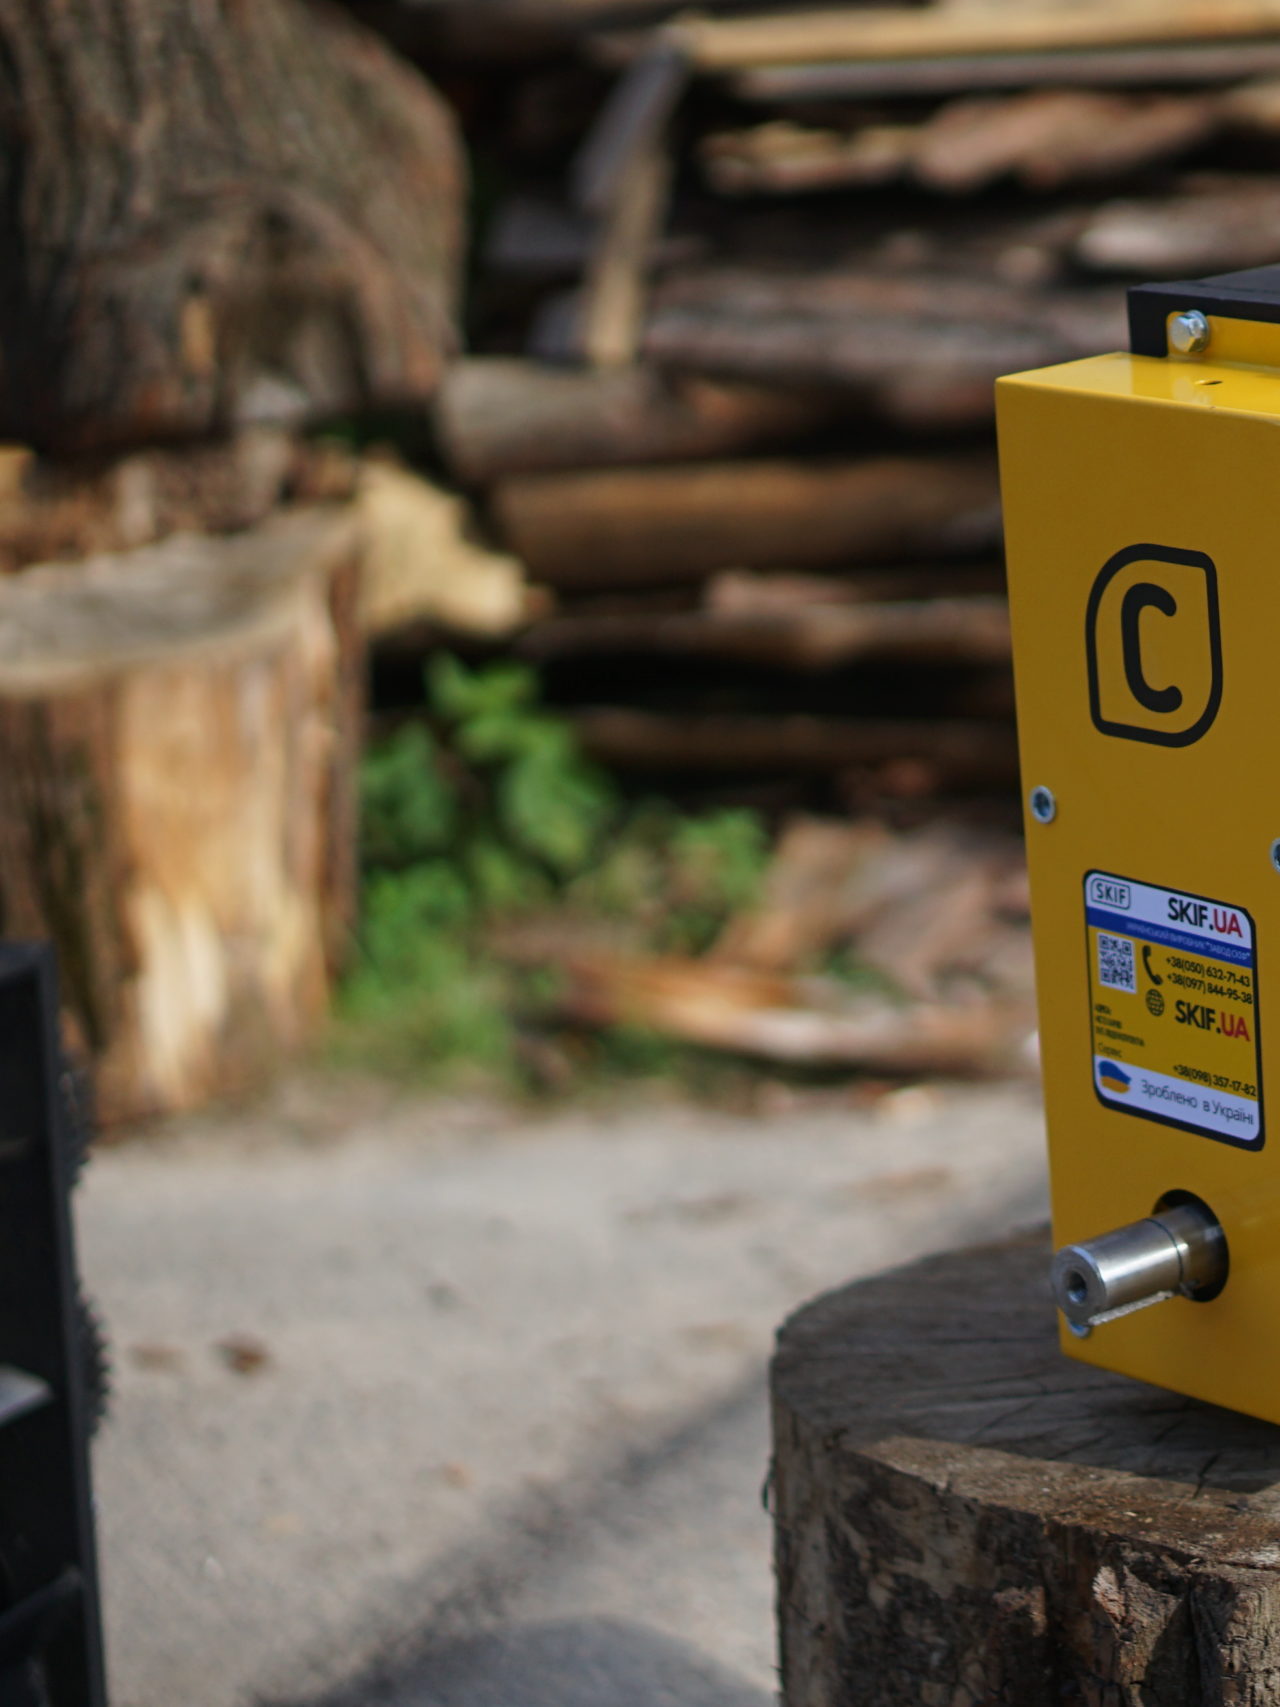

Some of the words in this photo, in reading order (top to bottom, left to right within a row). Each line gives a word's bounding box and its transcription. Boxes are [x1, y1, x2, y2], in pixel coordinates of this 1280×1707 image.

[1096, 883, 1126, 905] SKIF
[1168, 897, 1243, 938] SKIF.UA
[1166, 956, 1205, 978] +38(050)
[1206, 966, 1250, 987] 632-71-43
[1167, 973, 1206, 994] +38(097)
[1207, 982, 1253, 1005] 844-95-38
[1175, 1000, 1250, 1041] SKIF.UA
[1141, 1079, 1198, 1108] Зроблено
[1203, 1100, 1210, 1113] в
[1212, 1100, 1254, 1125] Україні
[1213, 1075, 1256, 1097] 357-17-82
